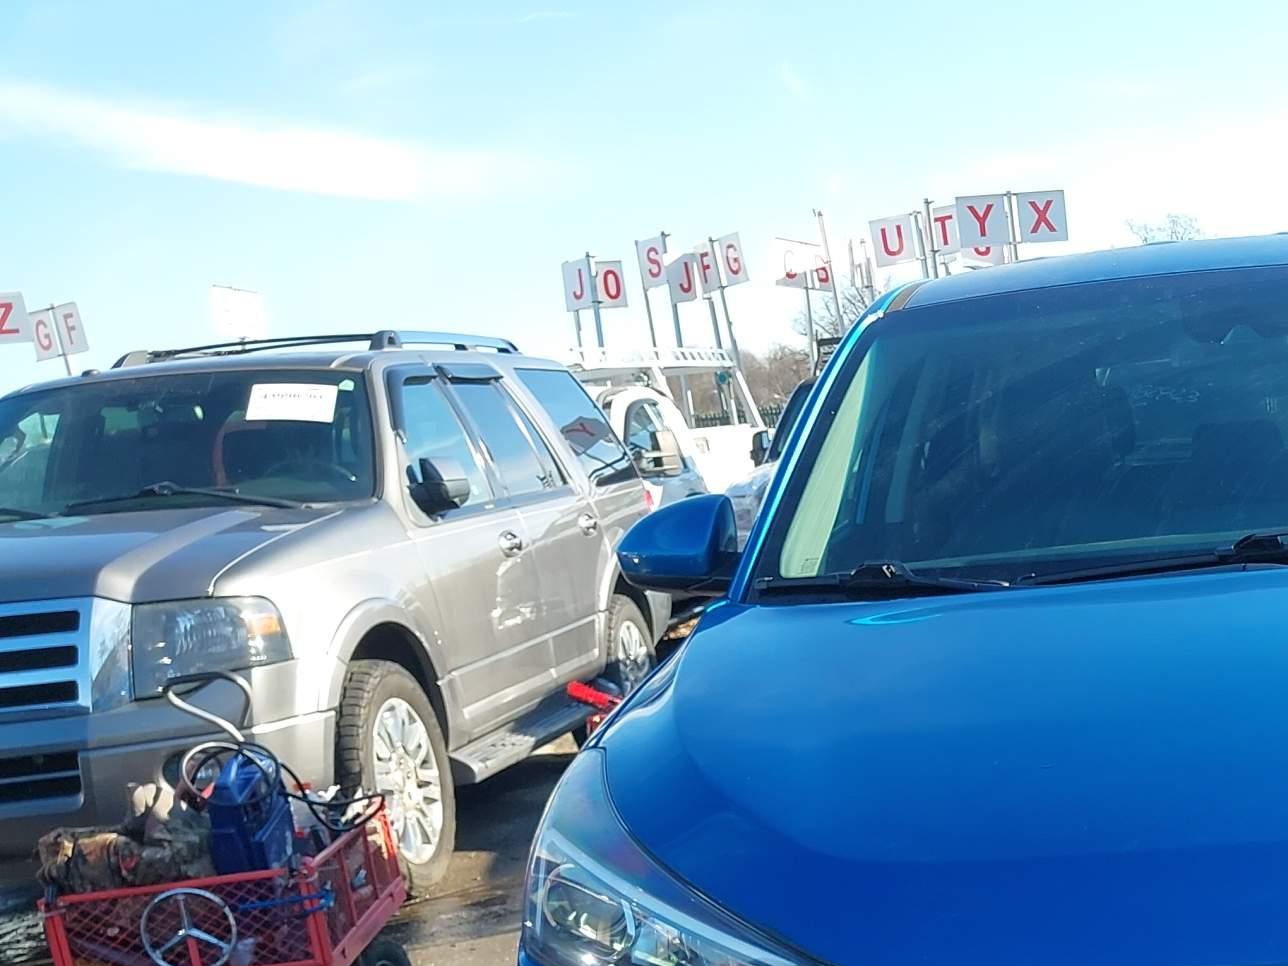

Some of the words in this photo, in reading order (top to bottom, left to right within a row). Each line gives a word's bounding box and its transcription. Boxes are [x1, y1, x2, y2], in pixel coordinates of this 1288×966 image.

[934, 214, 953, 246] T
[967, 203, 993, 237] Y
[1028, 199, 1057, 234] X
[880, 224, 904, 256] U
[647, 246, 662, 278] S
[699, 252, 711, 284] F
[726, 243, 742, 276] G
[573, 268, 584, 301] J
[679, 261, 692, 294] J
[35, 319, 53, 352] G
[62, 312, 76, 345] F
